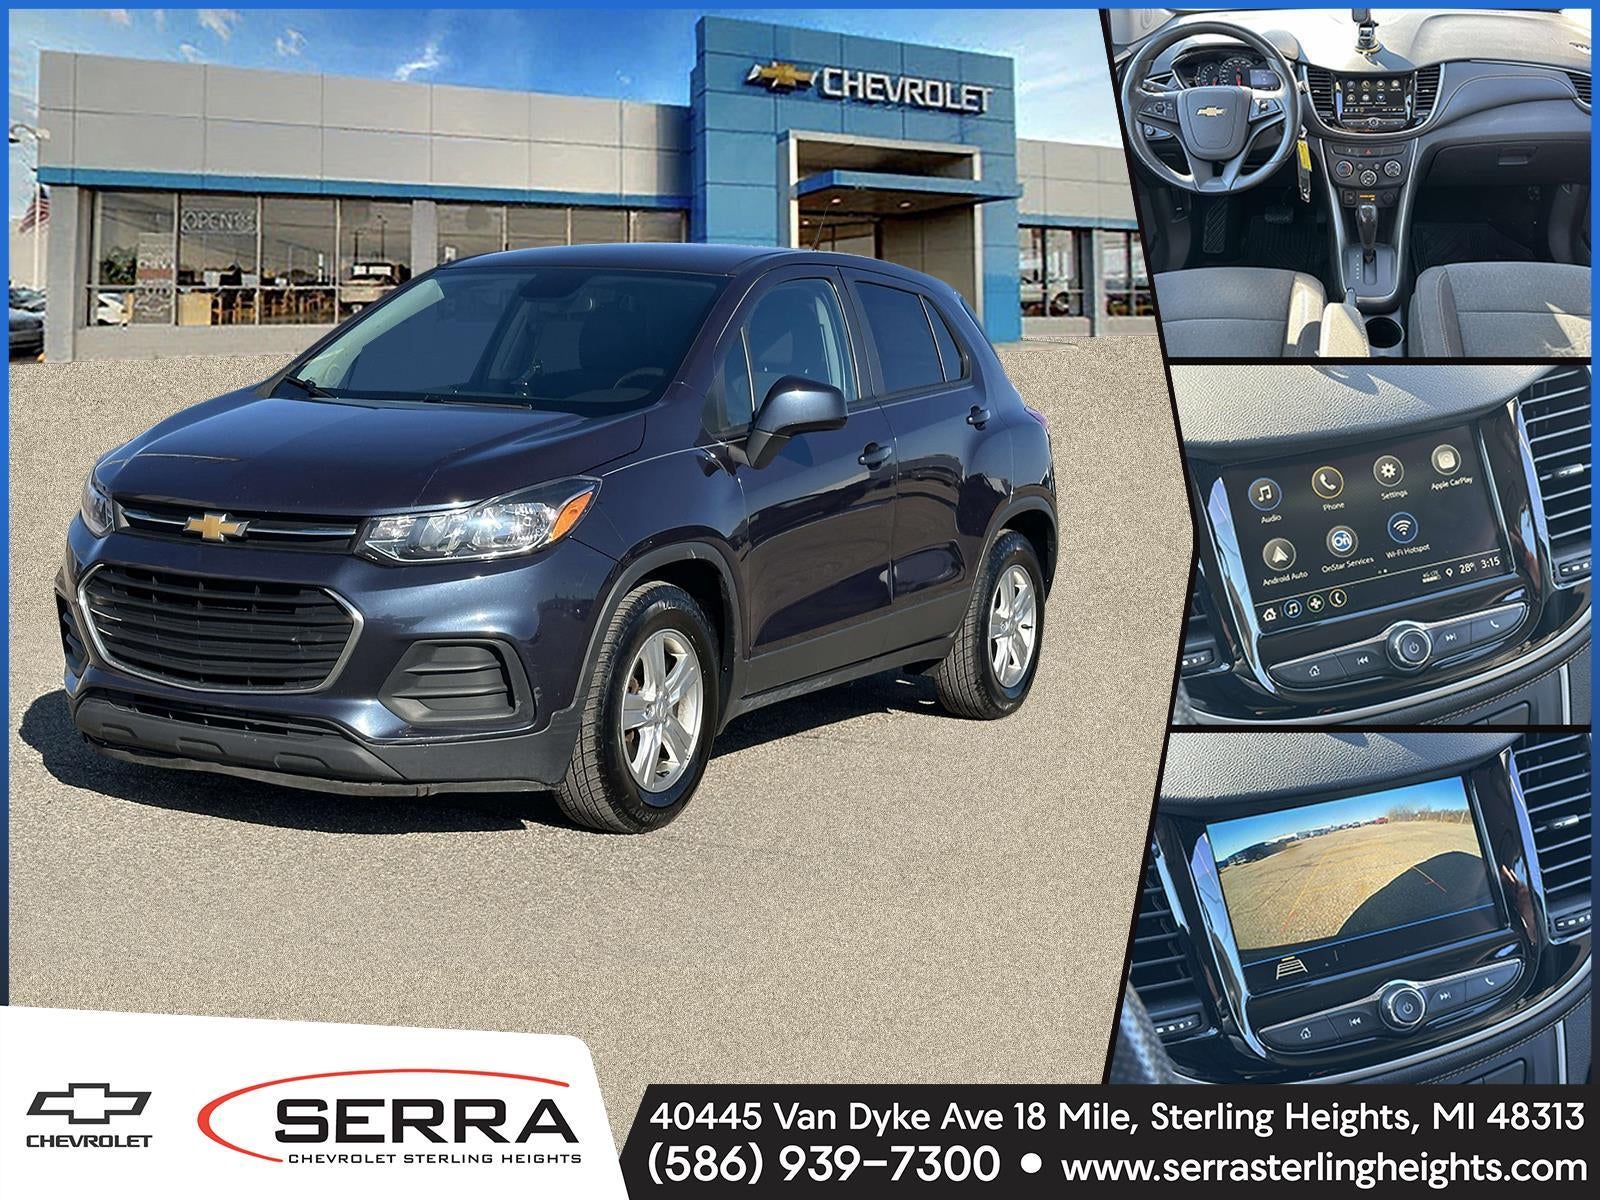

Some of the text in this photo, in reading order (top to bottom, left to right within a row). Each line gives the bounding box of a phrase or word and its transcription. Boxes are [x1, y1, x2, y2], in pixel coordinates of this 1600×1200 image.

[822, 67, 994, 112] CHEVROLET
[1431, 476, 1473, 491] Apple CarPlay
[1381, 489, 1408, 500] Settings
[1322, 502, 1345, 512] Phone
[1260, 514, 1282, 524] Audio
[1385, 543, 1431, 559] Wi-Fi Hotspot
[1321, 556, 1375, 573] OnStar Services
[1480, 556, 1501, 569] 3:15
[1262, 570, 1309, 587] Android Auto
